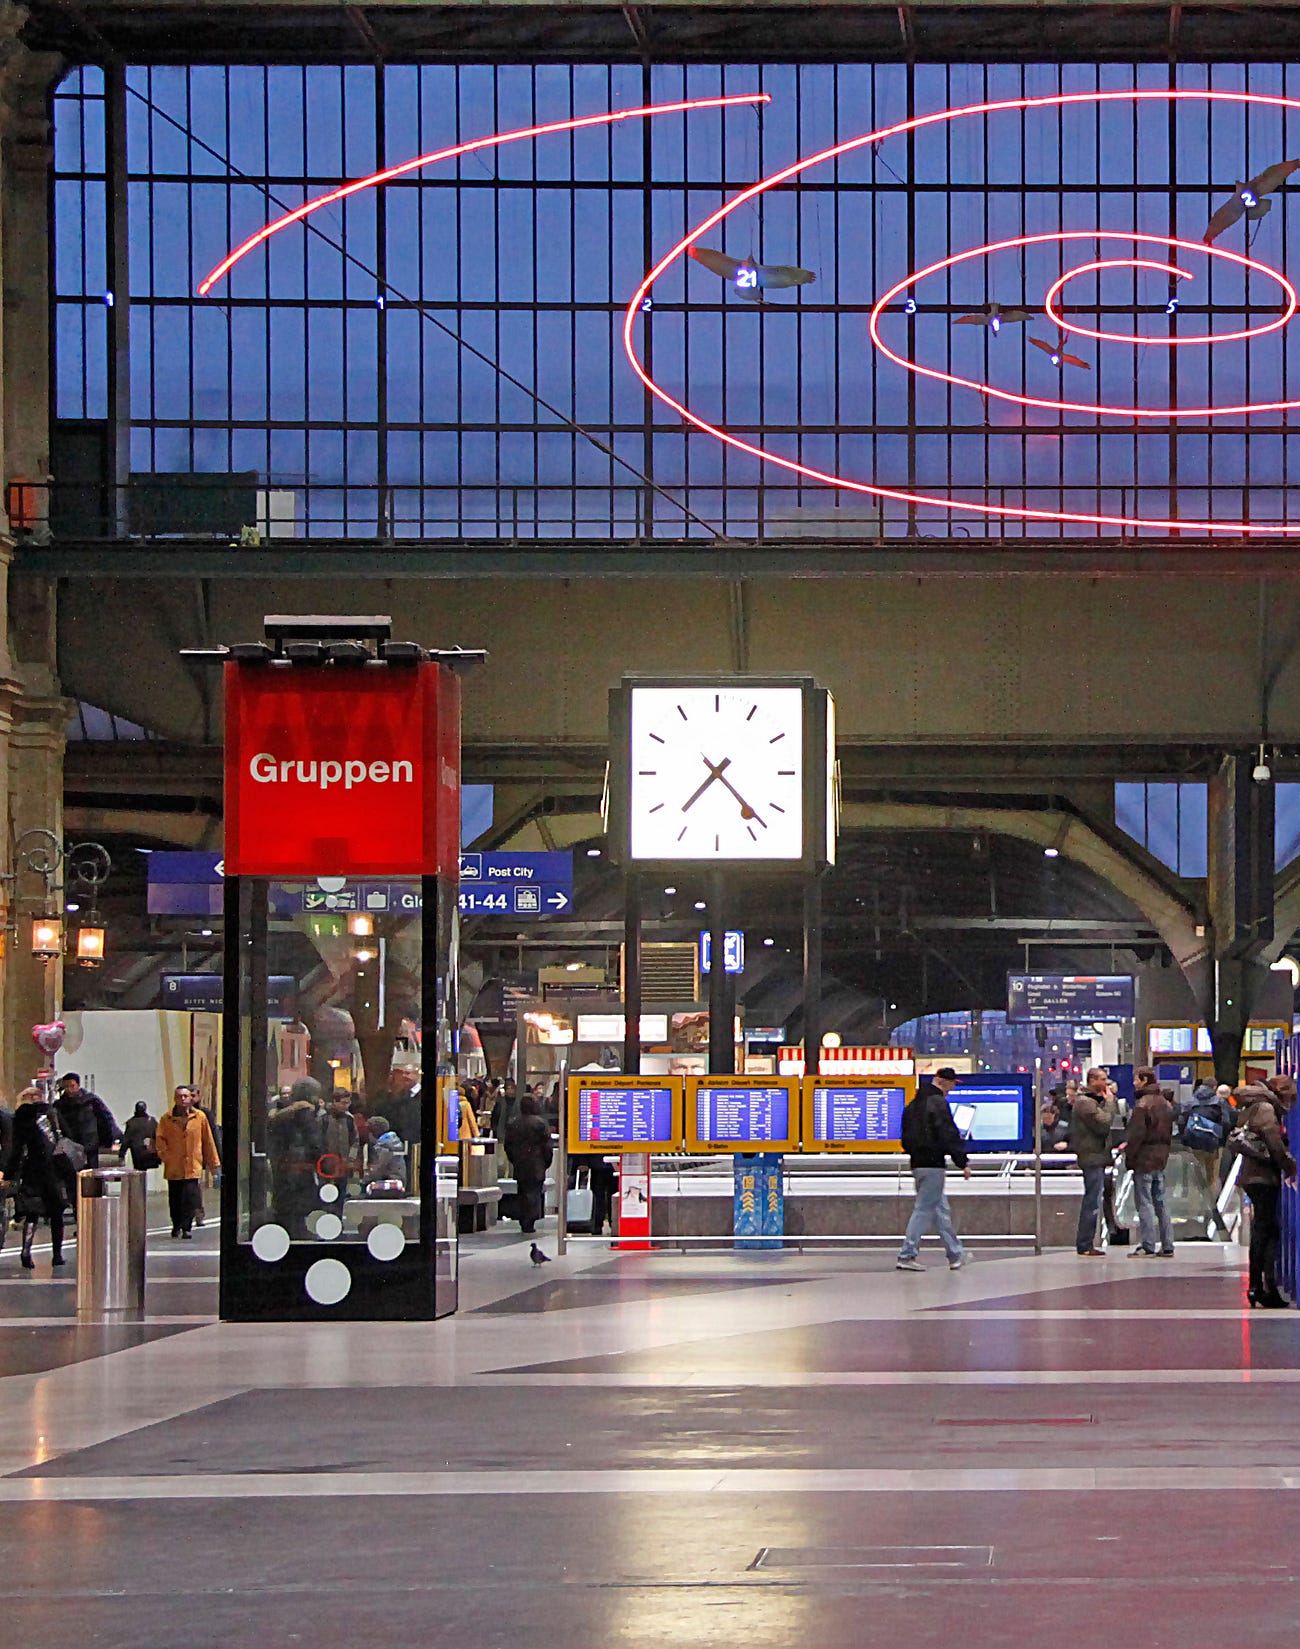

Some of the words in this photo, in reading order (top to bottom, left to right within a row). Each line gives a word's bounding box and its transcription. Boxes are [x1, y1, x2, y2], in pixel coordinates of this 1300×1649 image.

[1241, 192, 1257, 207] 2
[736, 269, 757, 288] 21
[377, 296, 384, 310] 1
[641, 298, 653, 312] 2
[904, 299, 917, 314] 3
[1165, 299, 1179, 314] 5
[250, 753, 413, 790] Gruppen
[488, 867, 511, 878] Post
[513, 867, 534, 879] City
[458, 893, 508, 910] 41-44
[1012, 982, 1023, 992] 10
